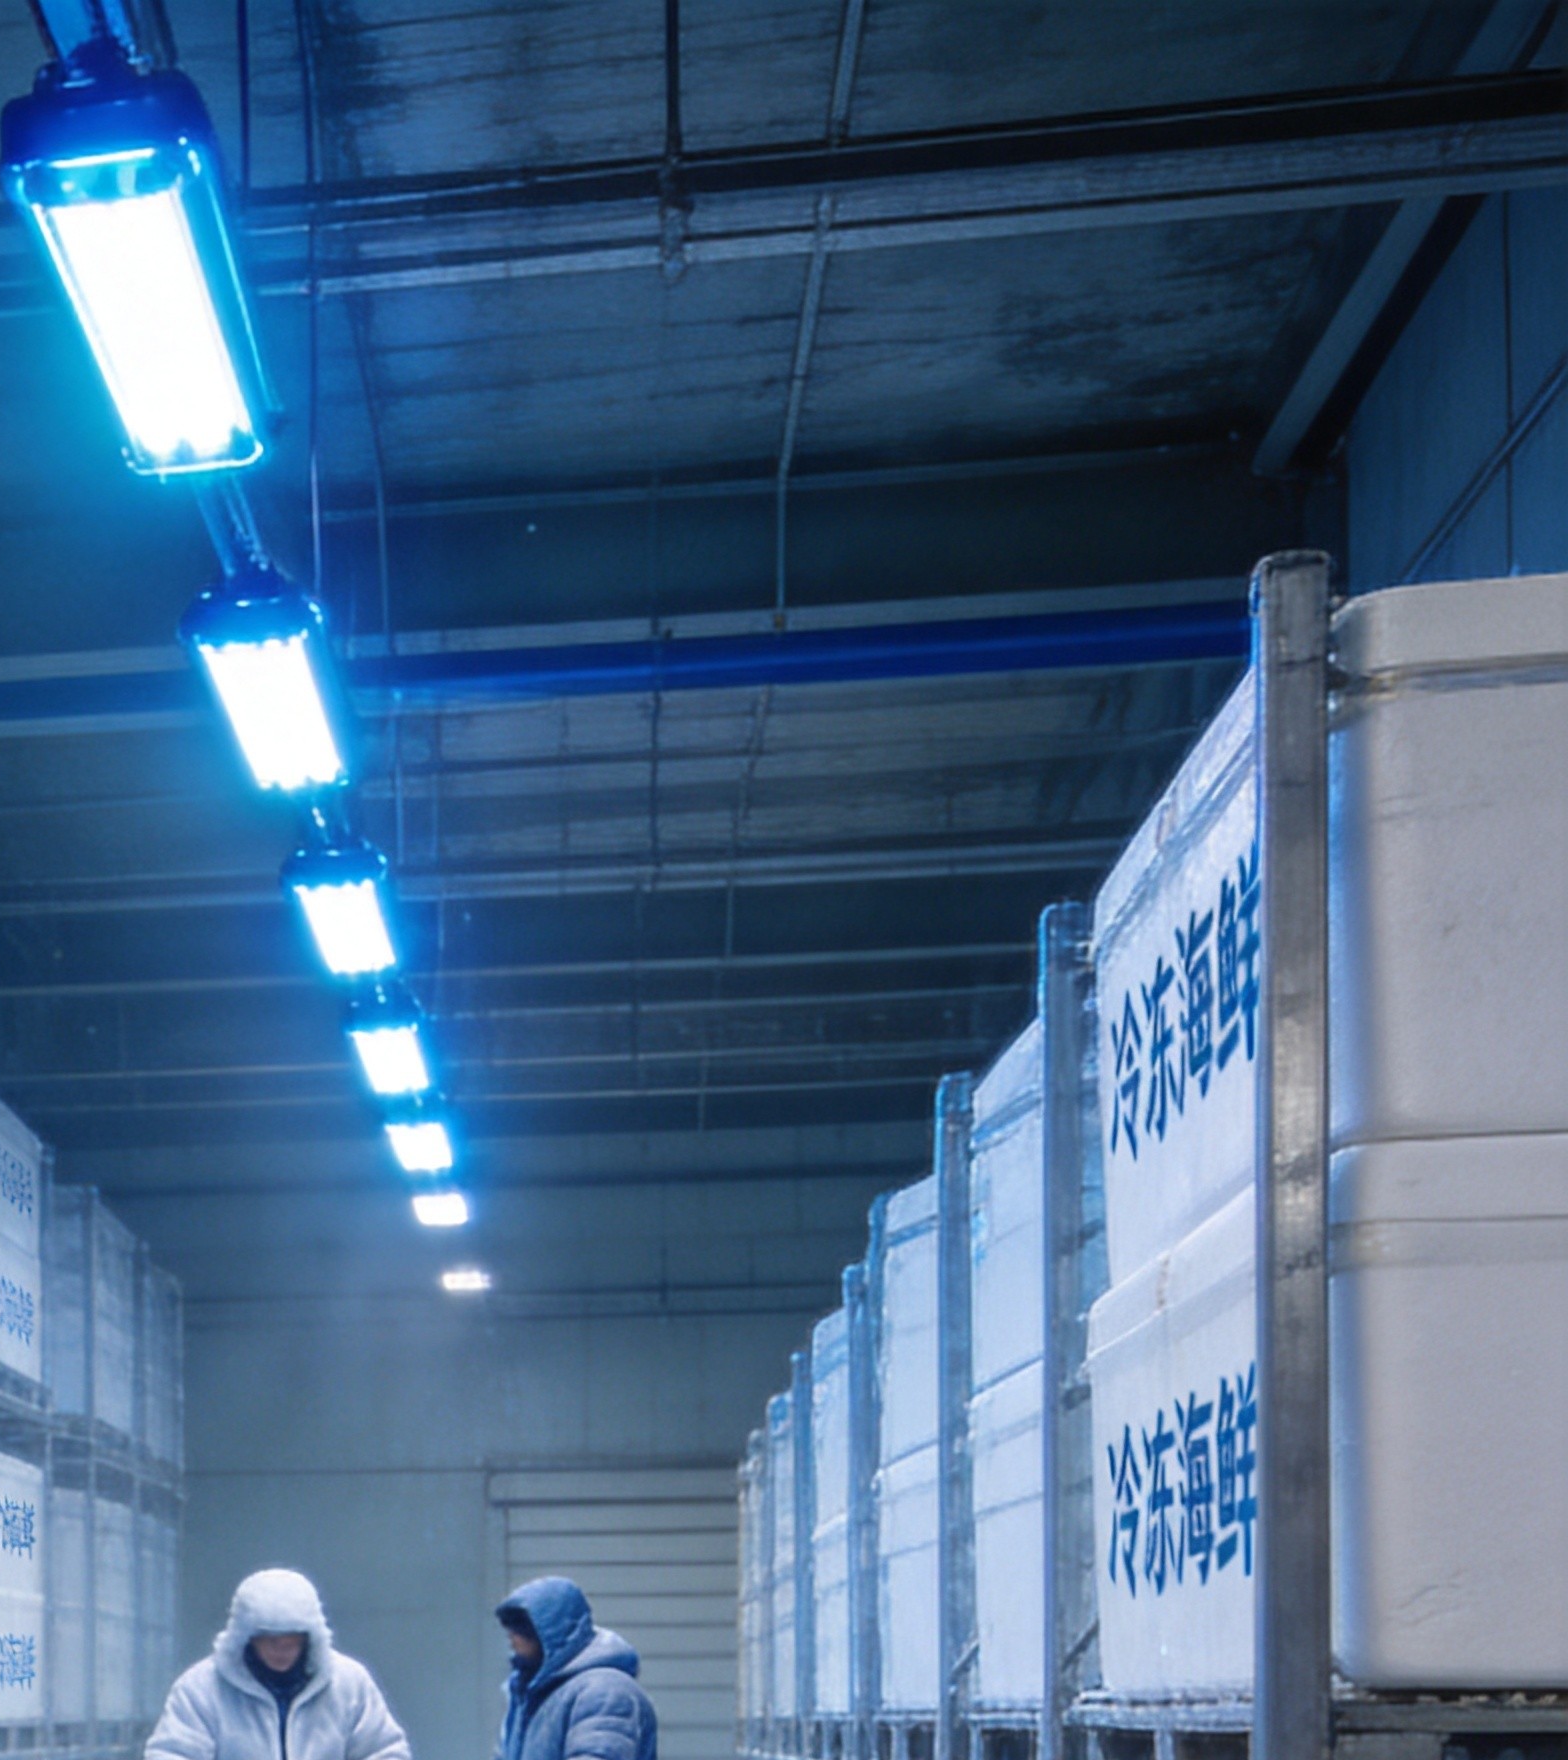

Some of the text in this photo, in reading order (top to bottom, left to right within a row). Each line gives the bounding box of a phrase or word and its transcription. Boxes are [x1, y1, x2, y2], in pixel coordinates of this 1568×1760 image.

[1111, 839, 1260, 1161] 冷冻海鲜
[1108, 1361, 1256, 1598] 冷冻海鲜
